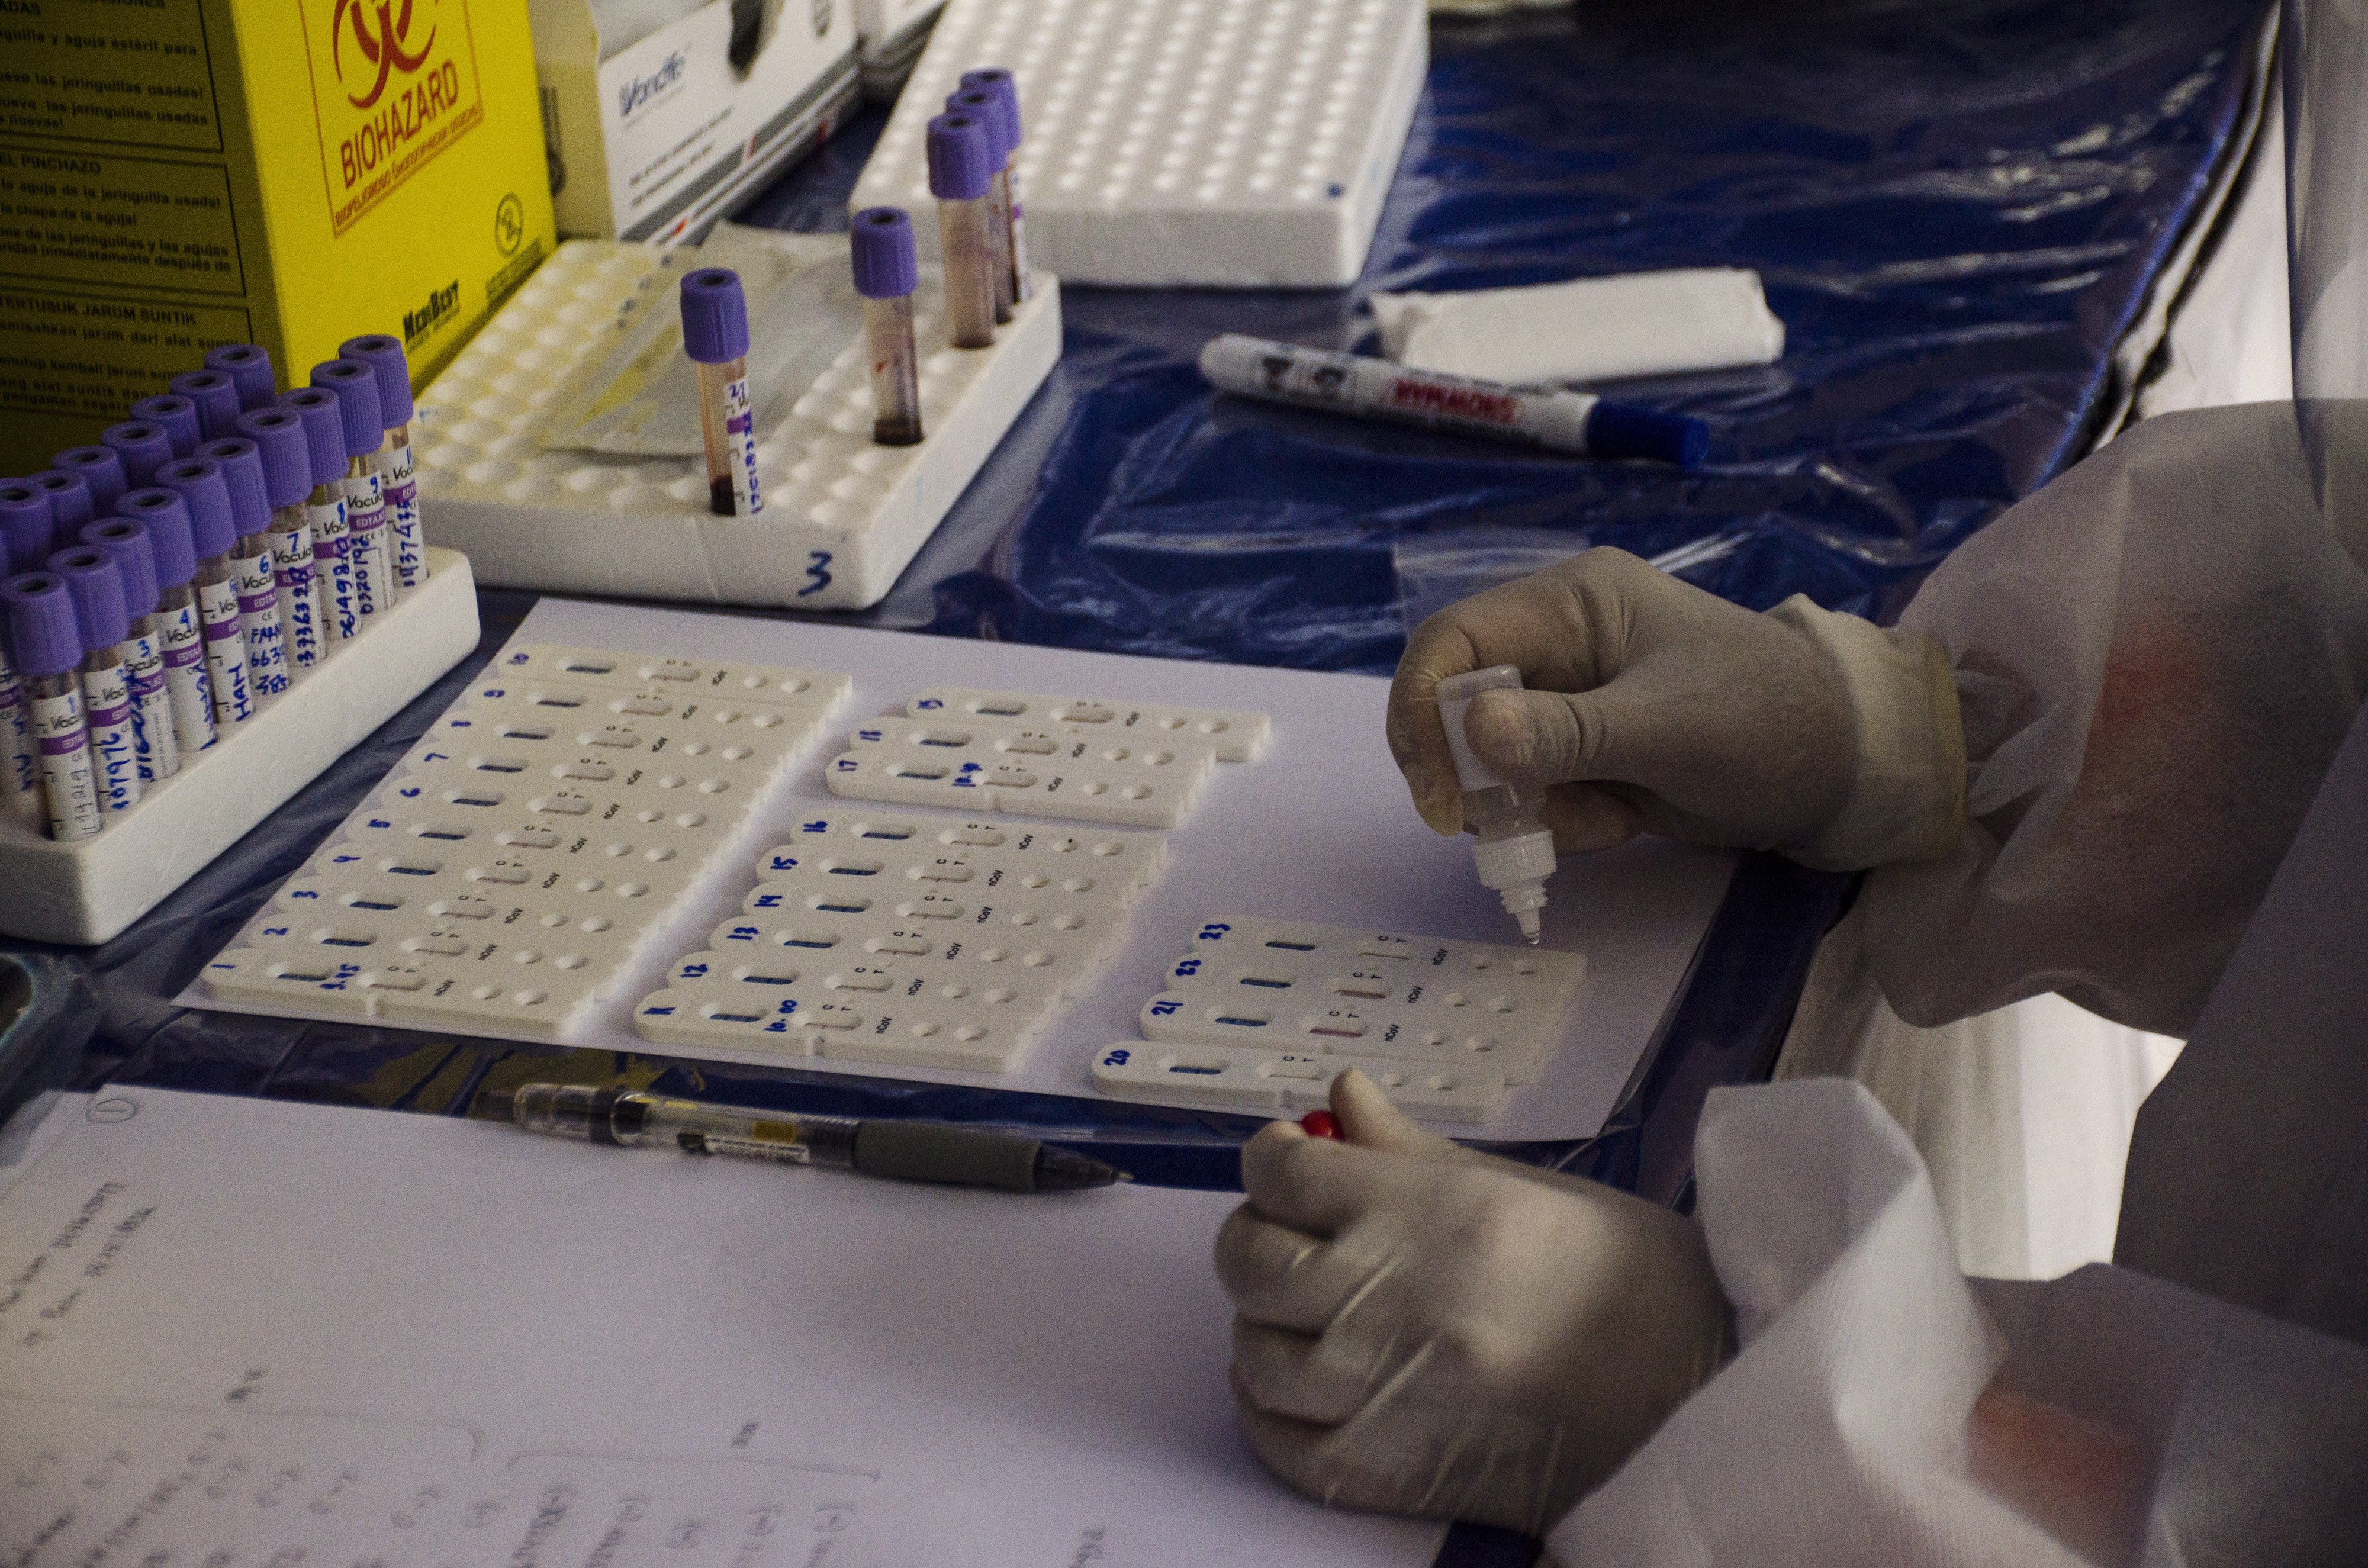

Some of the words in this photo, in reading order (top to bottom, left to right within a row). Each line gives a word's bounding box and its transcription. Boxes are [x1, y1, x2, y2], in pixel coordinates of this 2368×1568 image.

[0, 29, 44, 43] guilla
[65, 34, 105, 49] aguja
[164, 43, 197, 56] para
[36, 73, 56, 86] las
[340, 58, 459, 189] BIOHAZARD
[22, 154, 101, 175] PINCHAZO
[2, 179, 14, 191] la
[20, 181, 56, 196] aguja
[62, 183, 78, 197] de
[83, 185, 95, 198] la
[101, 186, 169, 205] jeringuilla
[83, 302, 136, 321] JARUM
[140, 307, 197, 326] SUNTIK
[287, 532, 298, 553] 7
[259, 554, 268, 574] 6
[797, 550, 832, 597] 3
[137, 639, 150, 658] 3
[424, 752, 448, 762] 7
[400, 788, 420, 798] 6
[803, 821, 827, 833] 16
[770, 856, 797, 870] 15
[988, 869, 1003, 887] nCoV
[292, 891, 318, 899] 3
[754, 895, 783, 907] 14
[977, 906, 993, 923] nCoV
[263, 927, 288, 936] 2
[727, 926, 759, 941] 13
[1199, 923, 1231, 940] 23
[945, 942, 962, 960] nCoV
[1432, 948, 1449, 966] nCoV
[680, 964, 708, 978] 12
[1175, 959, 1202, 977] 22
[907, 978, 924, 996] nCoV
[1407, 985, 1424, 1004] nCoV
[1151, 1000, 1183, 1016] 21
[876, 1016, 893, 1035] nCoV
[1384, 1023, 1401, 1042] nCoV
[1103, 1049, 1130, 1066] 20
